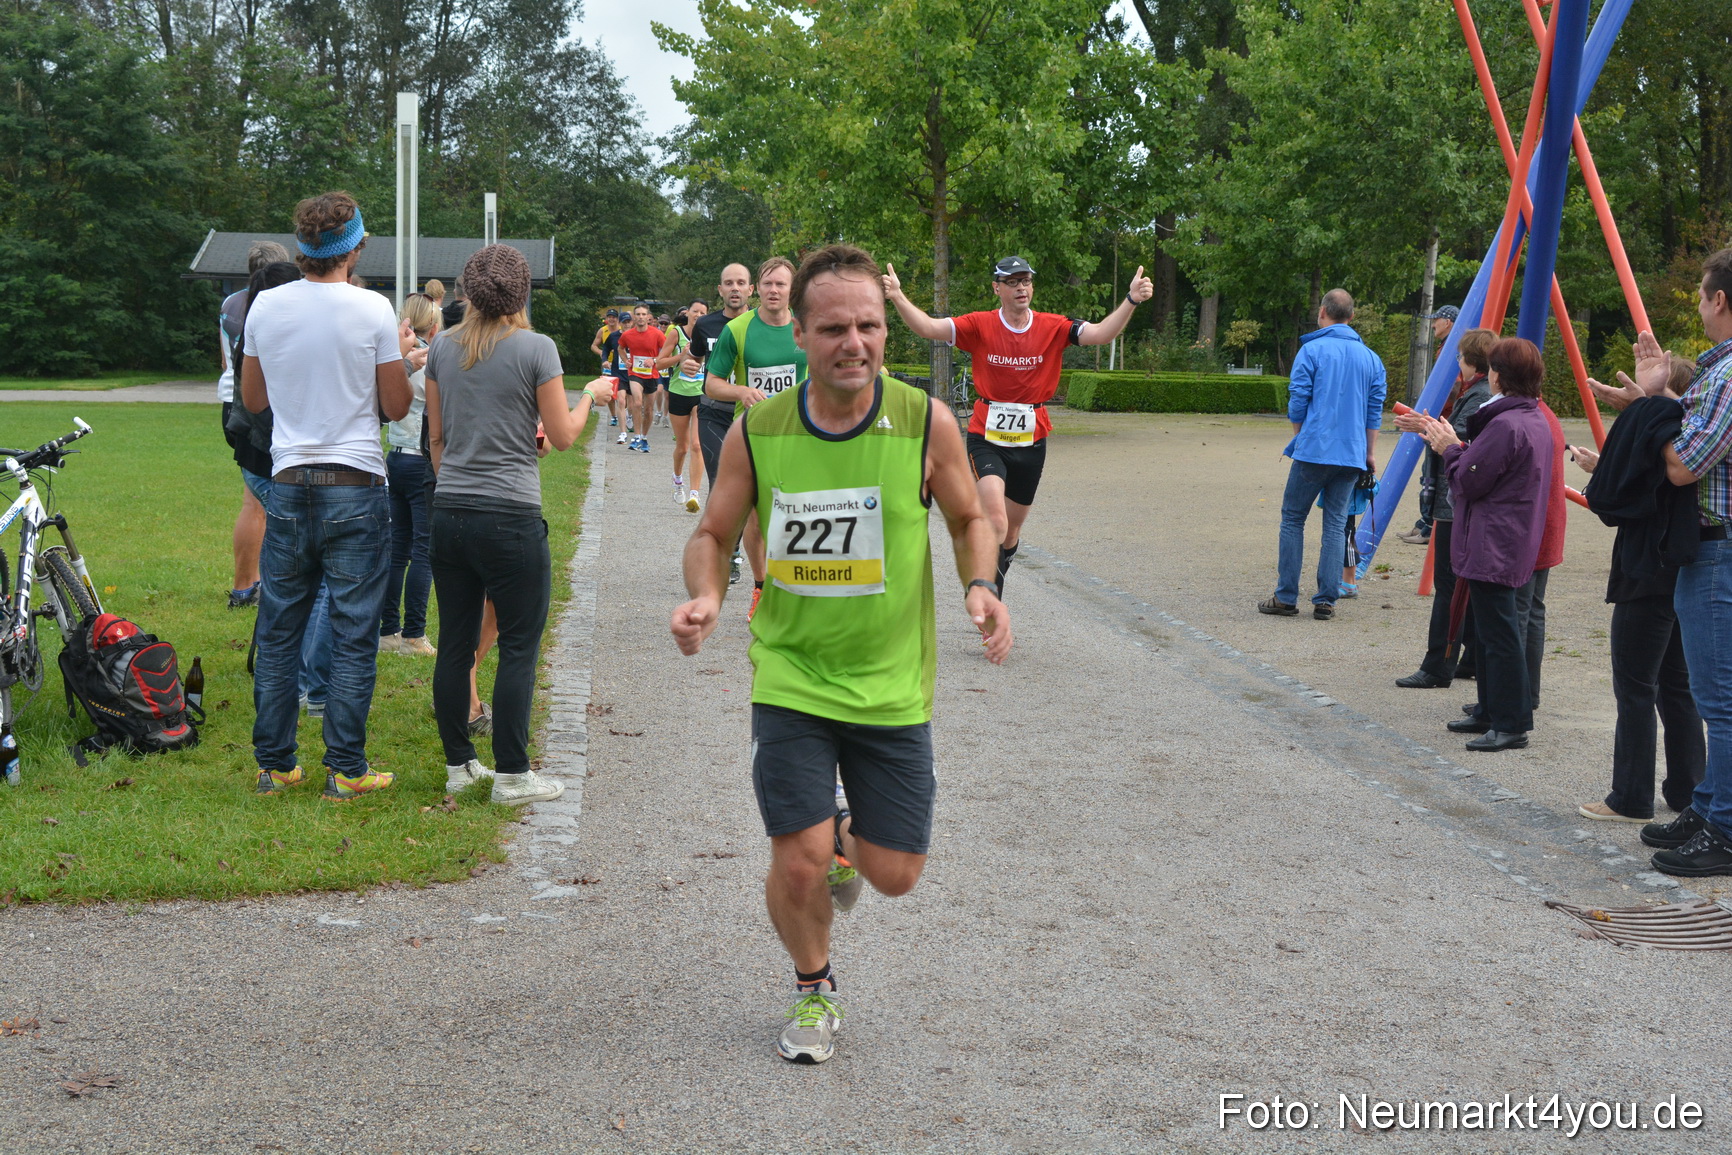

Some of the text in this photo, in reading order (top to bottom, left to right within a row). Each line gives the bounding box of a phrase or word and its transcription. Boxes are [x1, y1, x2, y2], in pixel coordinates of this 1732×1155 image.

[987, 353, 1037, 366] NEUMARKT
[754, 375, 793, 393] 2409
[996, 413, 1026, 430] 274
[999, 433, 1021, 442] Jürgen
[774, 498, 859, 514] PARTL Neumarkt
[785, 516, 857, 555] 227
[793, 565, 852, 581] Richard
